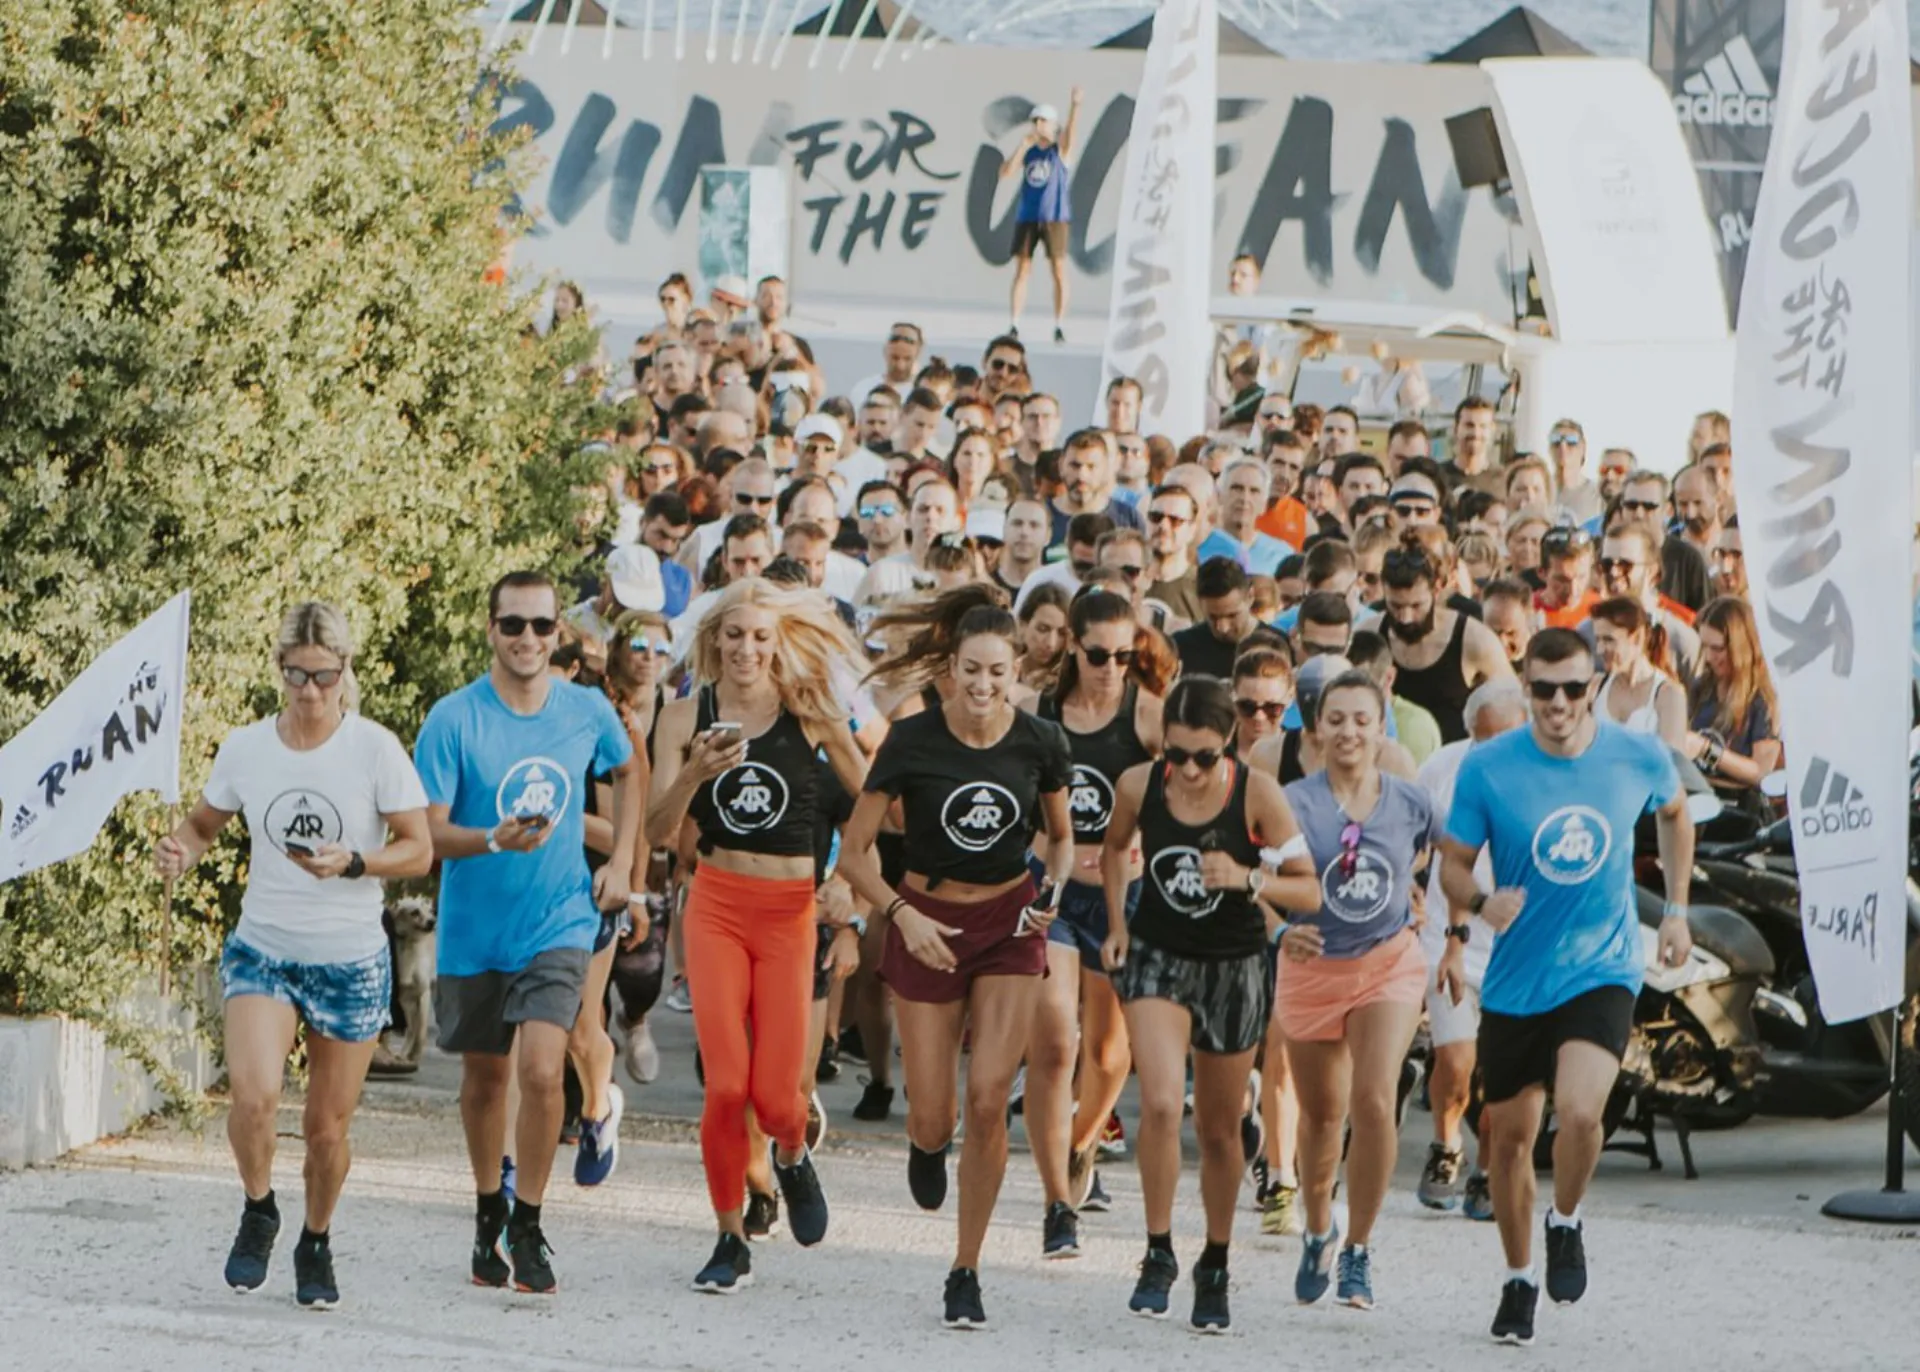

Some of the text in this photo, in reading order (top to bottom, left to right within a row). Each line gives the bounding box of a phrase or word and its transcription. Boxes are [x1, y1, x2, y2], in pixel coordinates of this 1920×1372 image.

[786, 111, 962, 181] FOR
[803, 189, 946, 266] THE
[283, 813, 325, 839] AR
